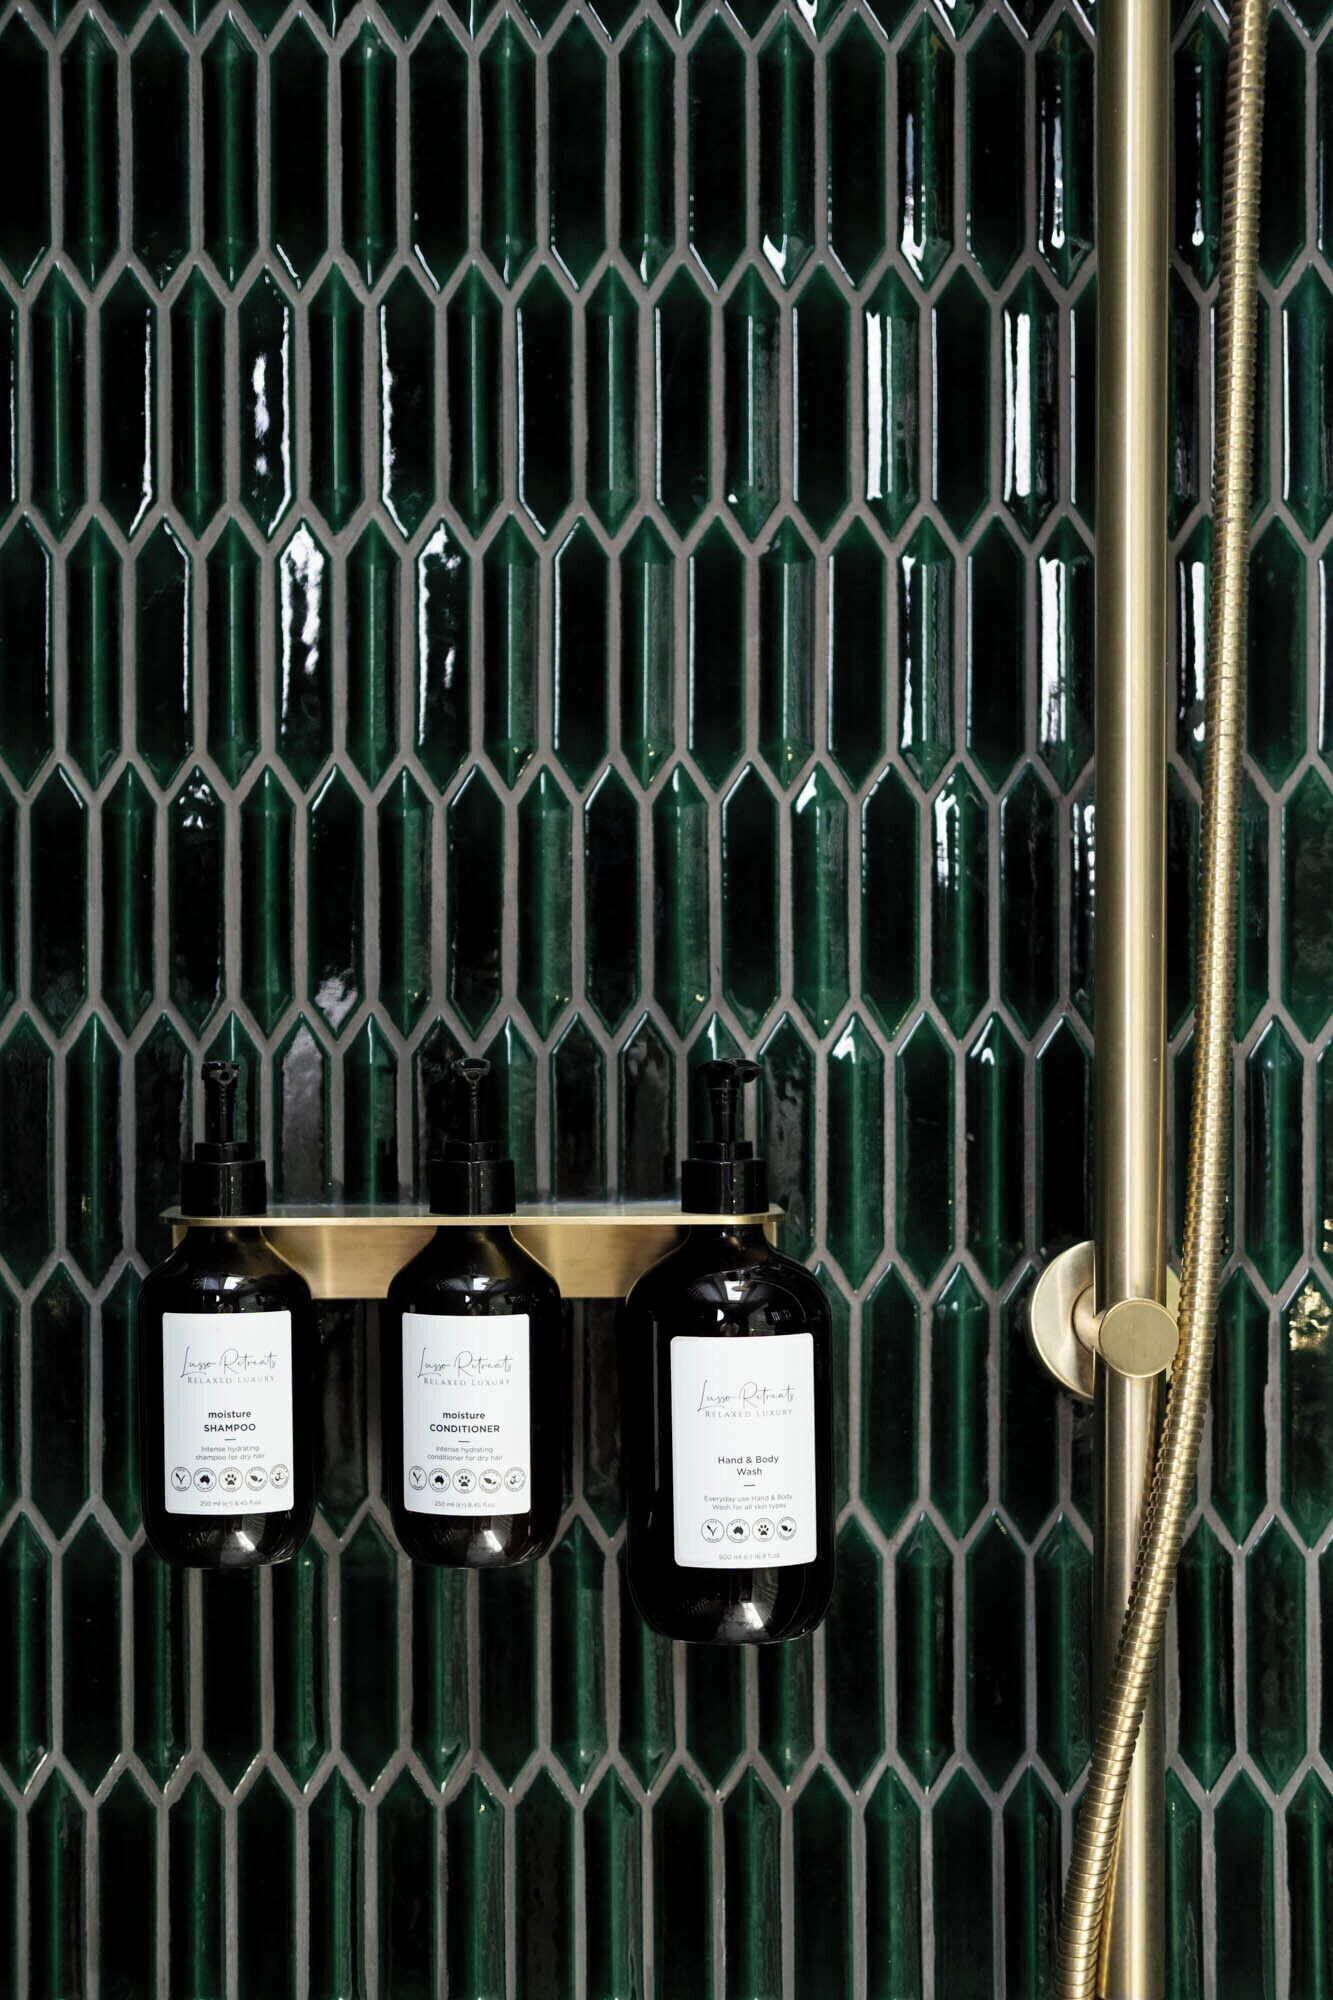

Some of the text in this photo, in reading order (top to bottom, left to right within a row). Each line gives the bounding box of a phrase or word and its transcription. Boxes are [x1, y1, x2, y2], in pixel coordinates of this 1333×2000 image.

[180, 1346, 279, 1378] Lusso Retreats
[417, 1347, 513, 1378] Lusso Retreats
[237, 1376, 275, 1384] LUXURY
[423, 1377, 511, 1386] RELAXED LUXURY
[697, 1379, 796, 1412] Lusso Retreats
[208, 1409, 252, 1419] moisture
[442, 1411, 486, 1420] moisture
[705, 1409, 793, 1418] RELAXED LUXURY
[203, 1423, 256, 1432] SHAMPOO
[429, 1423, 500, 1433] CONDITIONER
[227, 1445, 260, 1453] hydrating
[460, 1446, 493, 1454] hydrating
[717, 1455, 779, 1464] Hand & Body
[736, 1467, 763, 1476] Wash
[704, 1495, 735, 1503] Everyday
